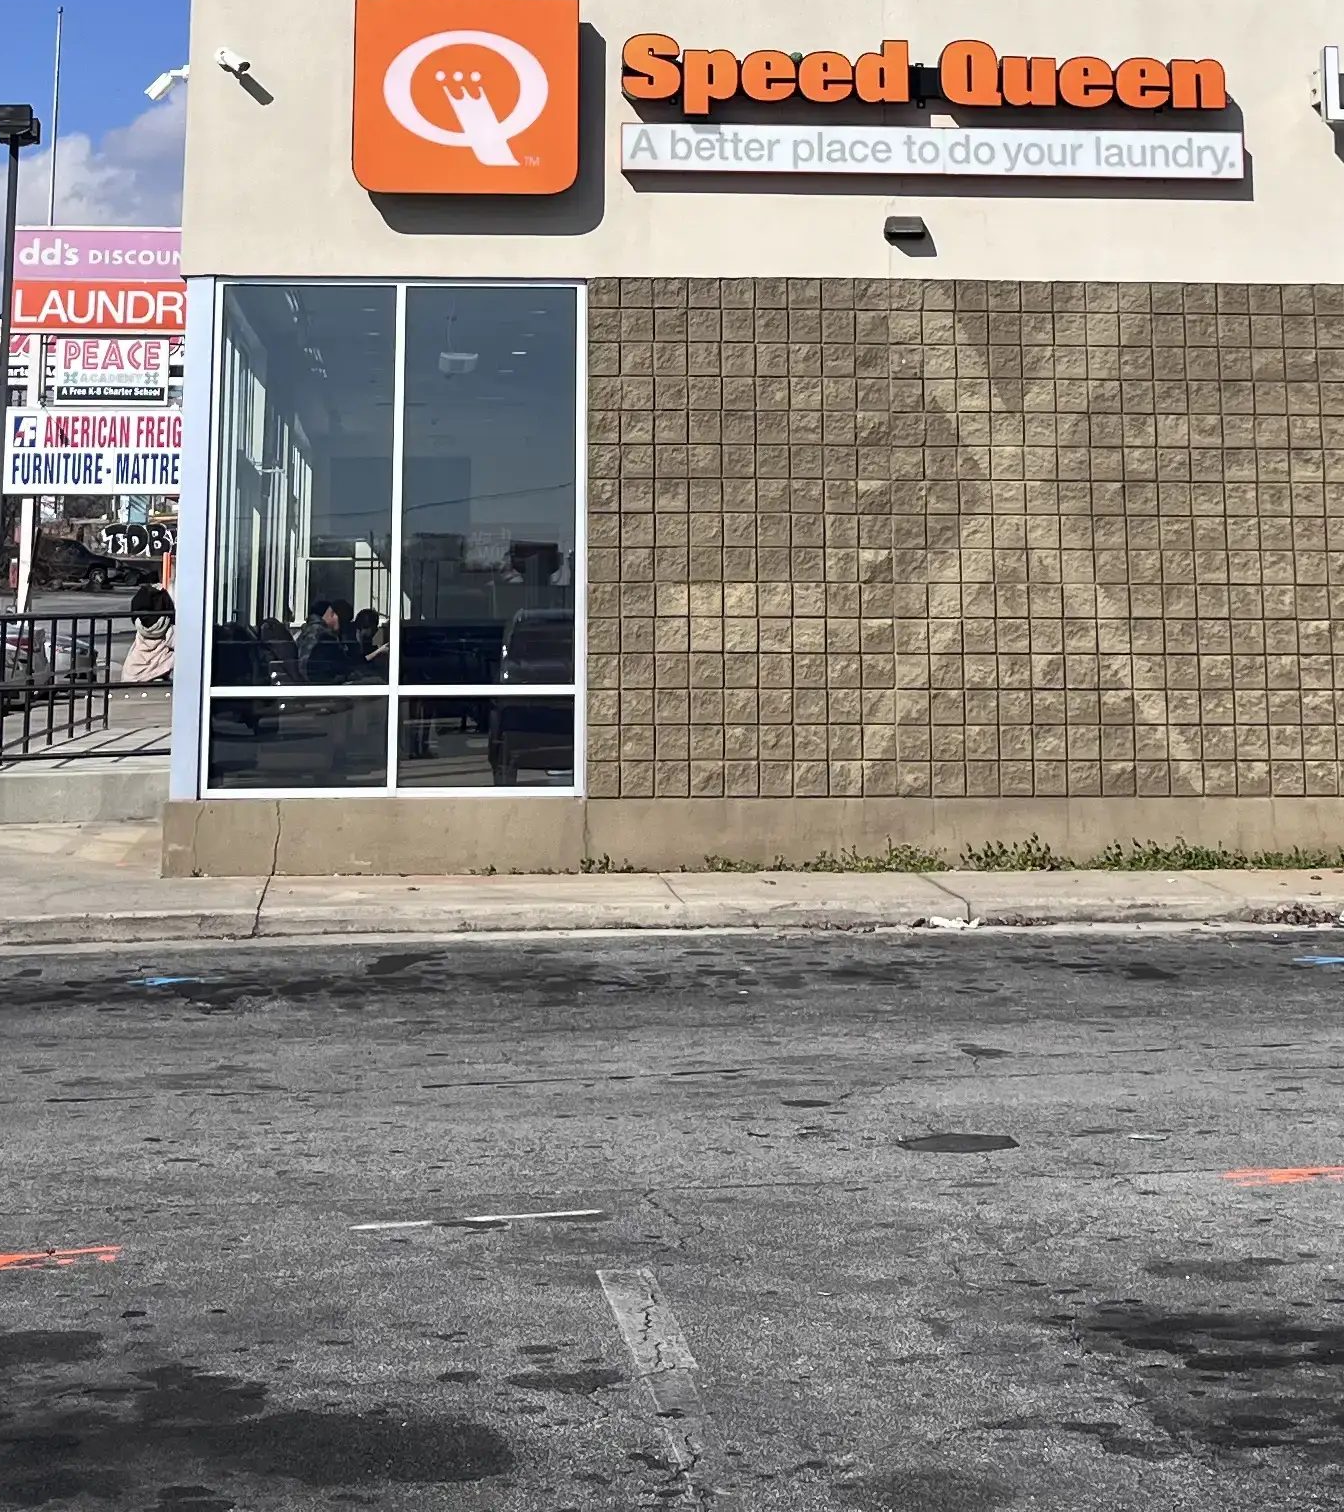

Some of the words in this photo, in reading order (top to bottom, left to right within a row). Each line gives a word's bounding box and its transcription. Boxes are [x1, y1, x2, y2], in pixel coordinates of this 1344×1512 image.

[621, 33, 909, 115] Speed
[939, 39, 1226, 109] Queen
[629, 129, 658, 161] A
[670, 129, 781, 162] better
[792, 131, 892, 169] place
[903, 134, 940, 163] to
[949, 133, 995, 165] do
[1005, 140, 1083, 172] your
[1094, 137, 1237, 176] laundry.
[19, 238, 79, 266] dd's
[14, 289, 187, 324] LAUNDR
[63, 340, 161, 370] PEACE
[61, 387, 68, 395] A
[69, 387, 87, 396] Free
[89, 387, 102, 395] K-8
[103, 387, 132, 396] Charter
[133, 388, 161, 396] School
[44, 416, 130, 448] AMERICAN
[12, 453, 104, 485] FURNITURE
[115, 453, 180, 485] MATTRE
